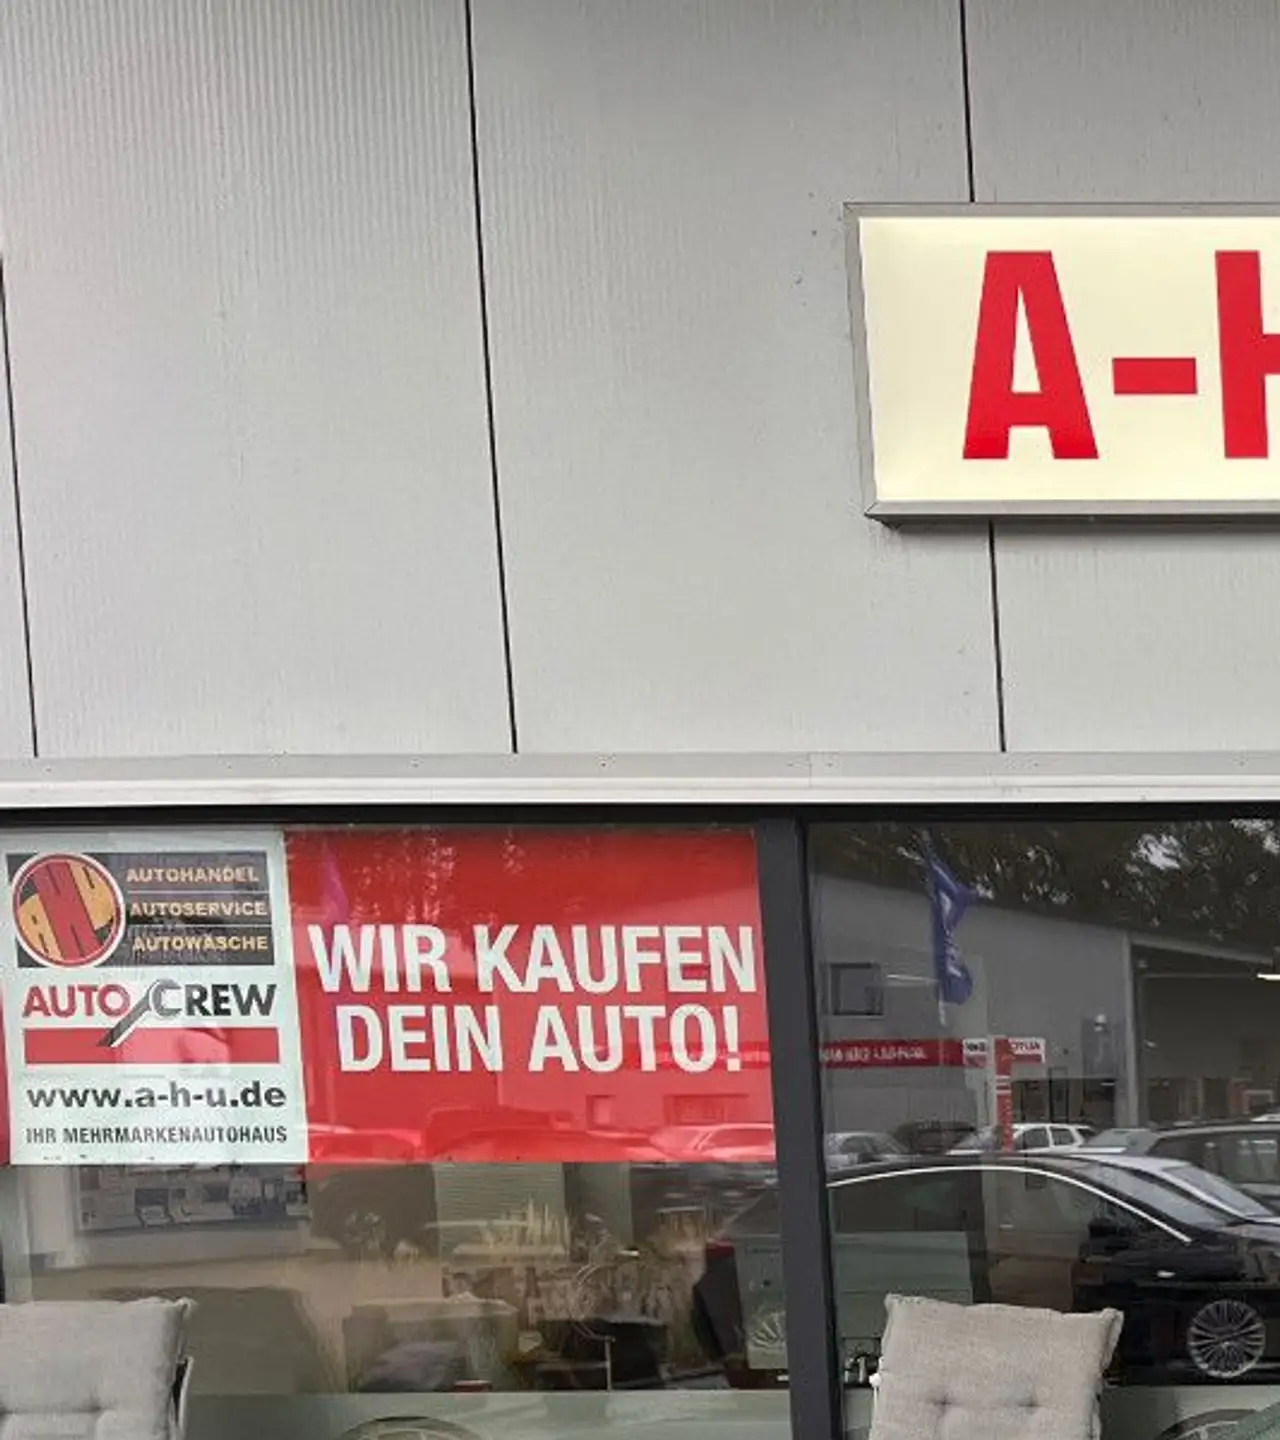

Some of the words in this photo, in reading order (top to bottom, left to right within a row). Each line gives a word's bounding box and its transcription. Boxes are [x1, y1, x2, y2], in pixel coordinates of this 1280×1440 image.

[126, 865, 260, 883] AUTOHANDEL
[130, 901, 268, 917] AUTOSERVICE
[308, 926, 464, 993] WIR
[478, 924, 757, 993] KAUFEN
[22, 984, 131, 1018] AUTO
[339, 1006, 500, 1072] DEIN
[528, 1005, 742, 1072] AUTO!
[26, 1081, 287, 1108] www.a-h-u.de
[26, 1128, 56, 1144] IHR
[63, 1125, 287, 1144] MEHRMARKENAUTOHAUS
